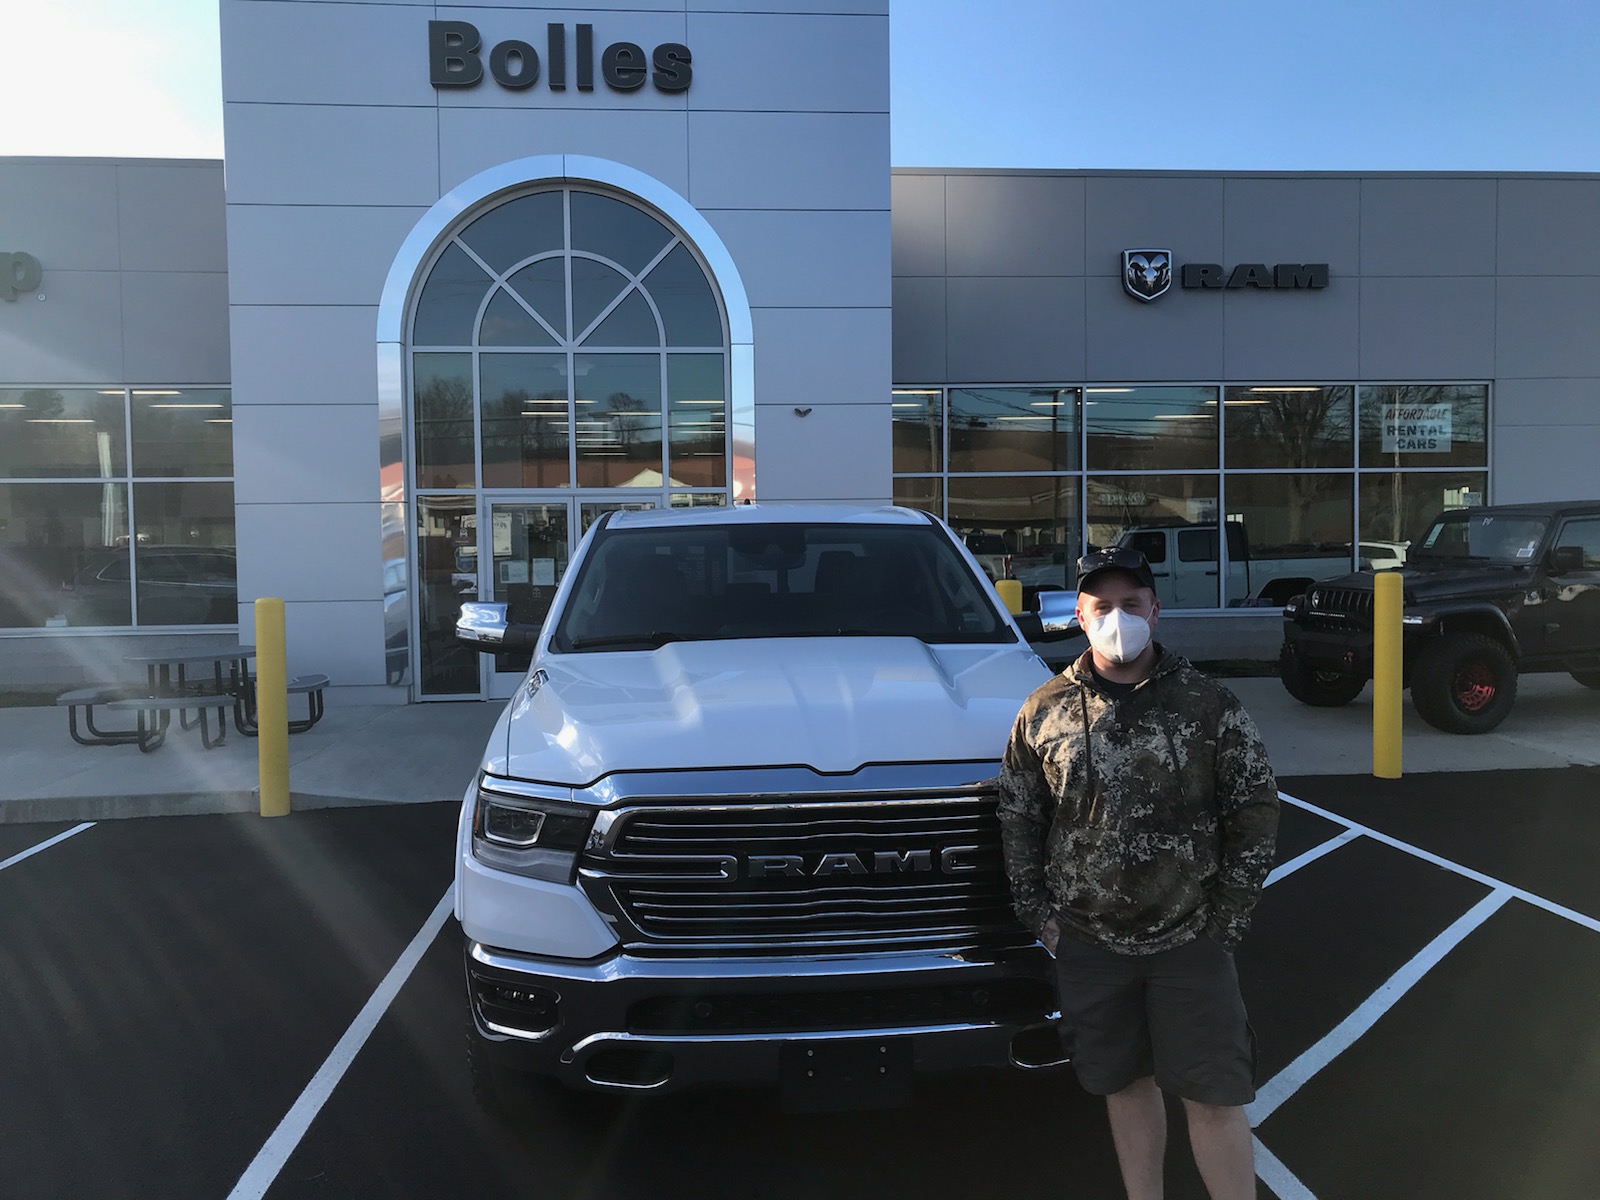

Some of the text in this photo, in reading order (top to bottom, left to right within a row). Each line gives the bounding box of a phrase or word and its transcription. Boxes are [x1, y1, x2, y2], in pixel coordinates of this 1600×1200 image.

[428, 20, 693, 92] Bolles
[1181, 263, 1329, 289] RAM
[1386, 425, 1448, 436] RENTAL
[1397, 438, 1437, 449] CARS
[748, 849, 933, 877] RAM
